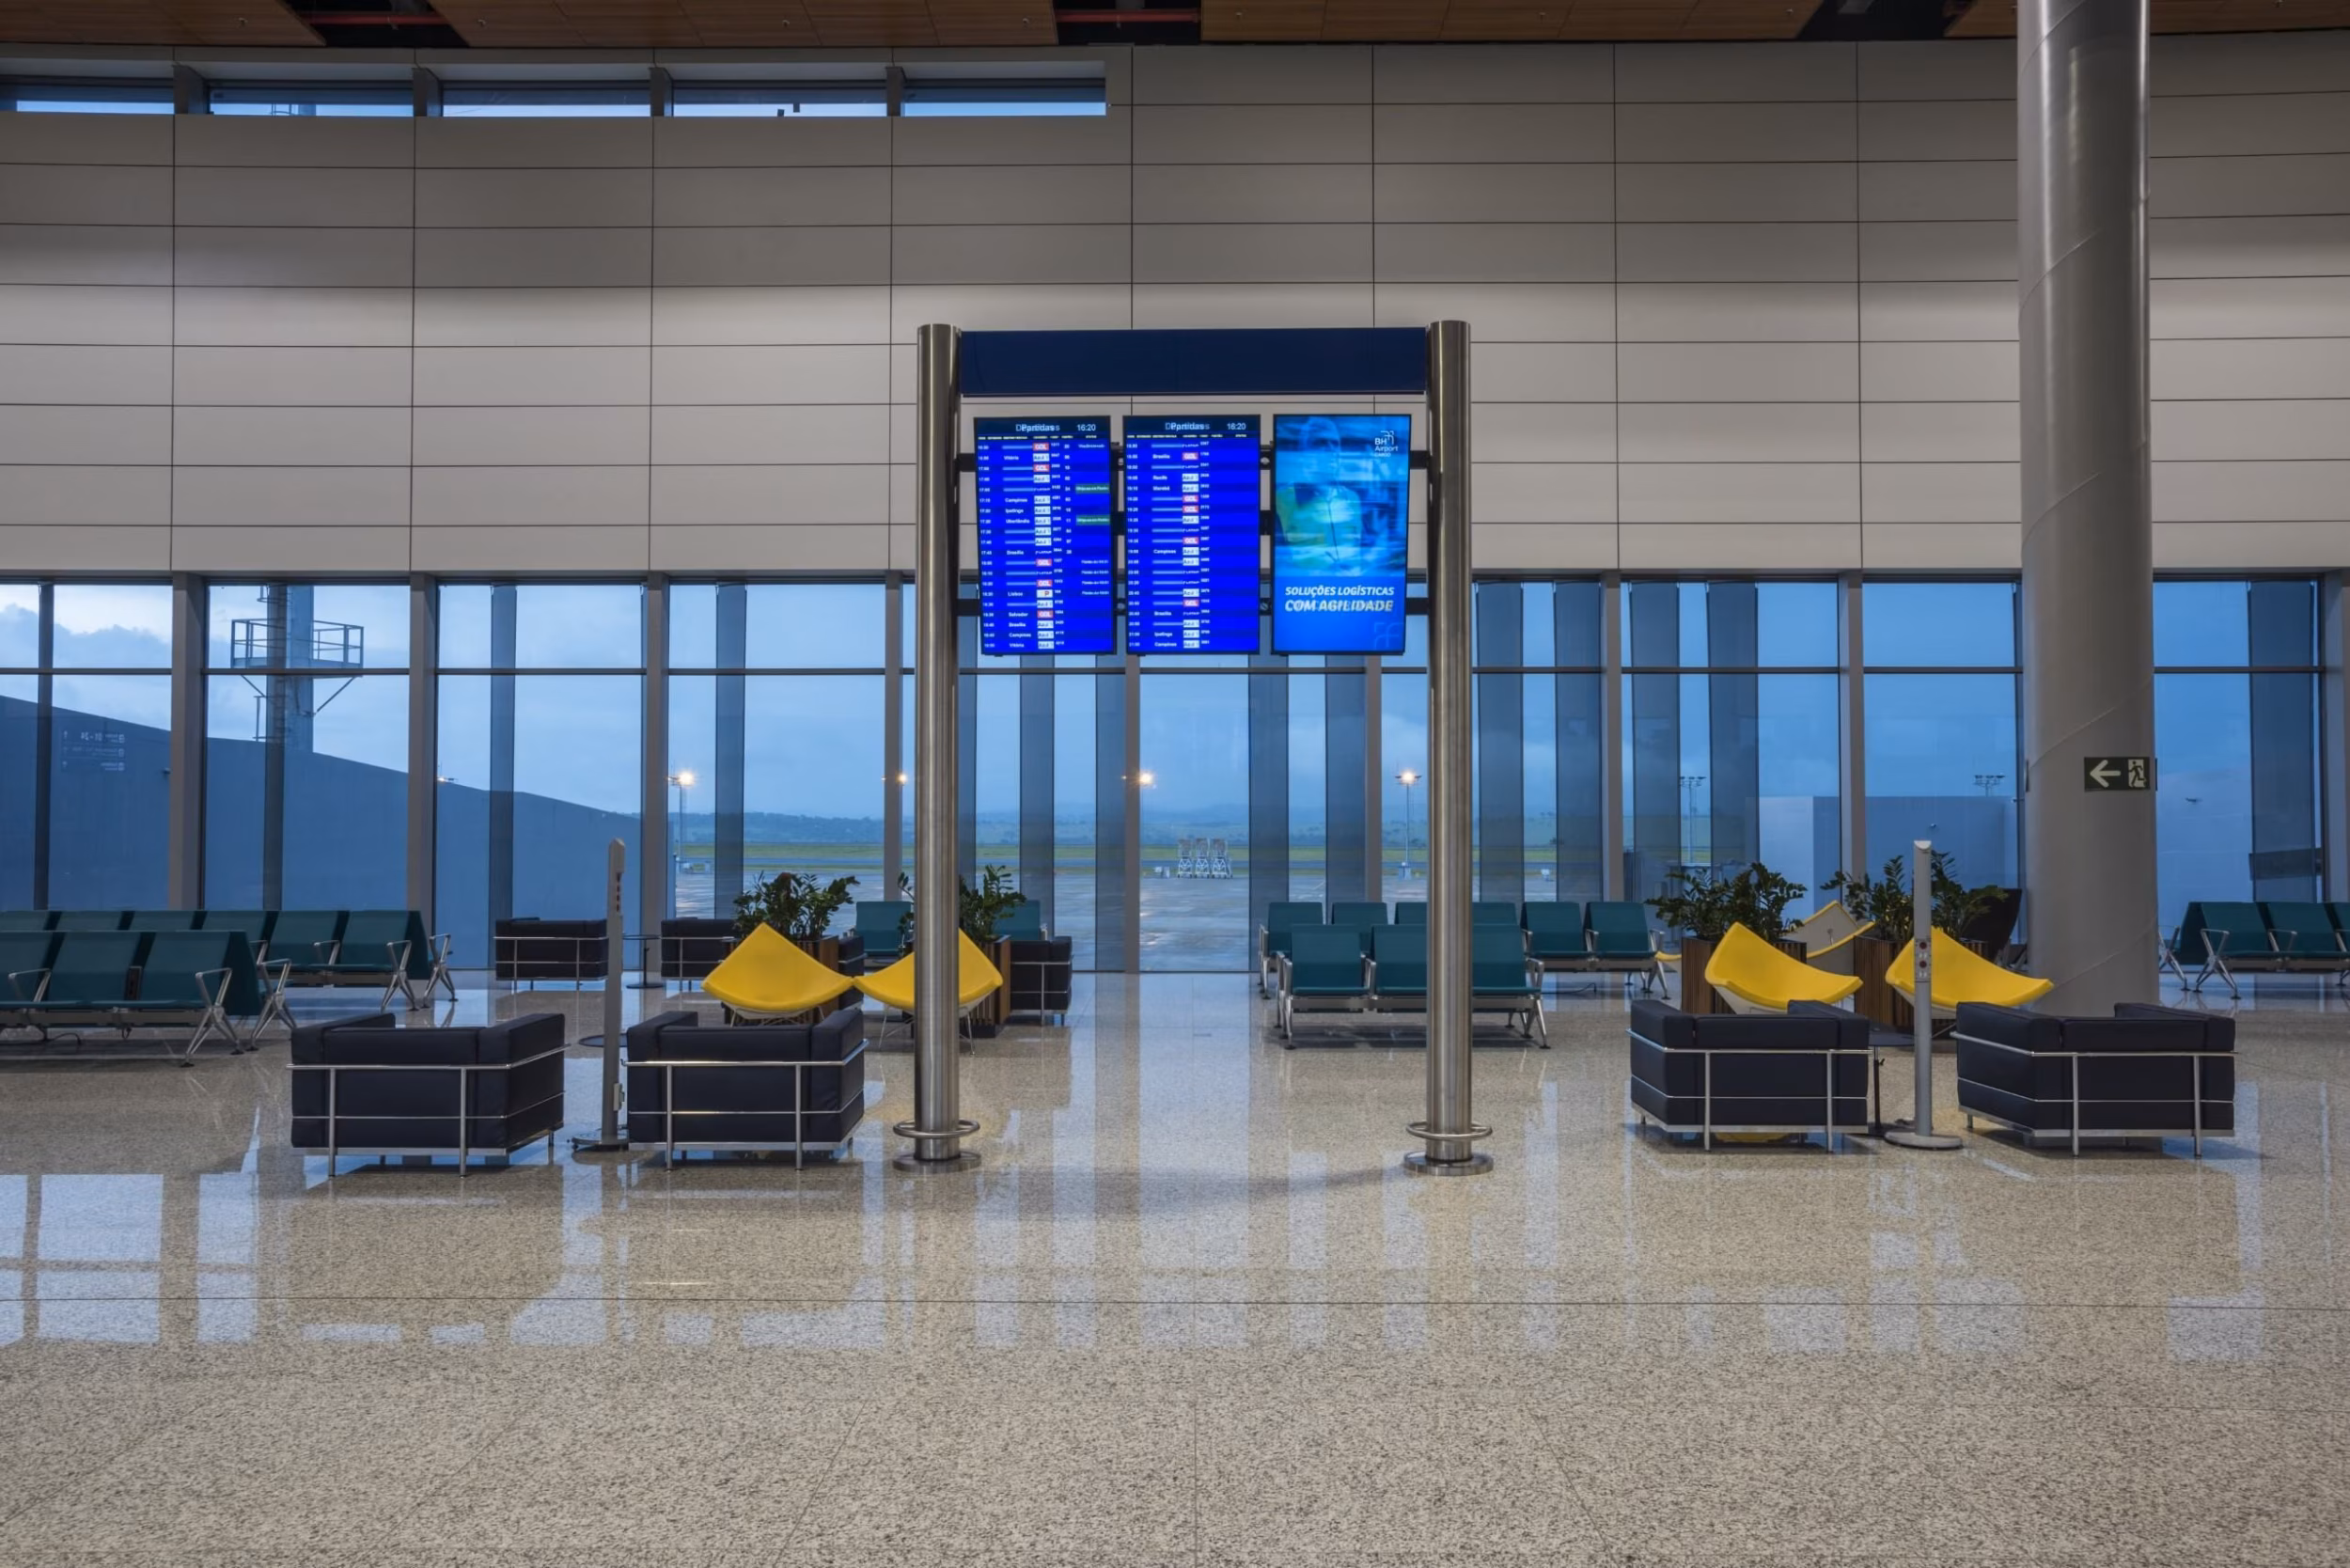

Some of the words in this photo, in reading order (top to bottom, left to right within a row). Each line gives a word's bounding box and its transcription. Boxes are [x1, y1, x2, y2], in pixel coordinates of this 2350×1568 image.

[1076, 423, 1096, 431] 16:20
[1227, 422, 1246, 431] 16:20
[1374, 437, 1387, 446] BH
[1374, 445, 1399, 453] Airport
[1285, 585, 1336, 598] SOLUÇÕES
[1338, 585, 1395, 596] LOGÍSTICAS
[1285, 600, 1316, 612] COM
[1319, 600, 1394, 612] AGILIDADE
